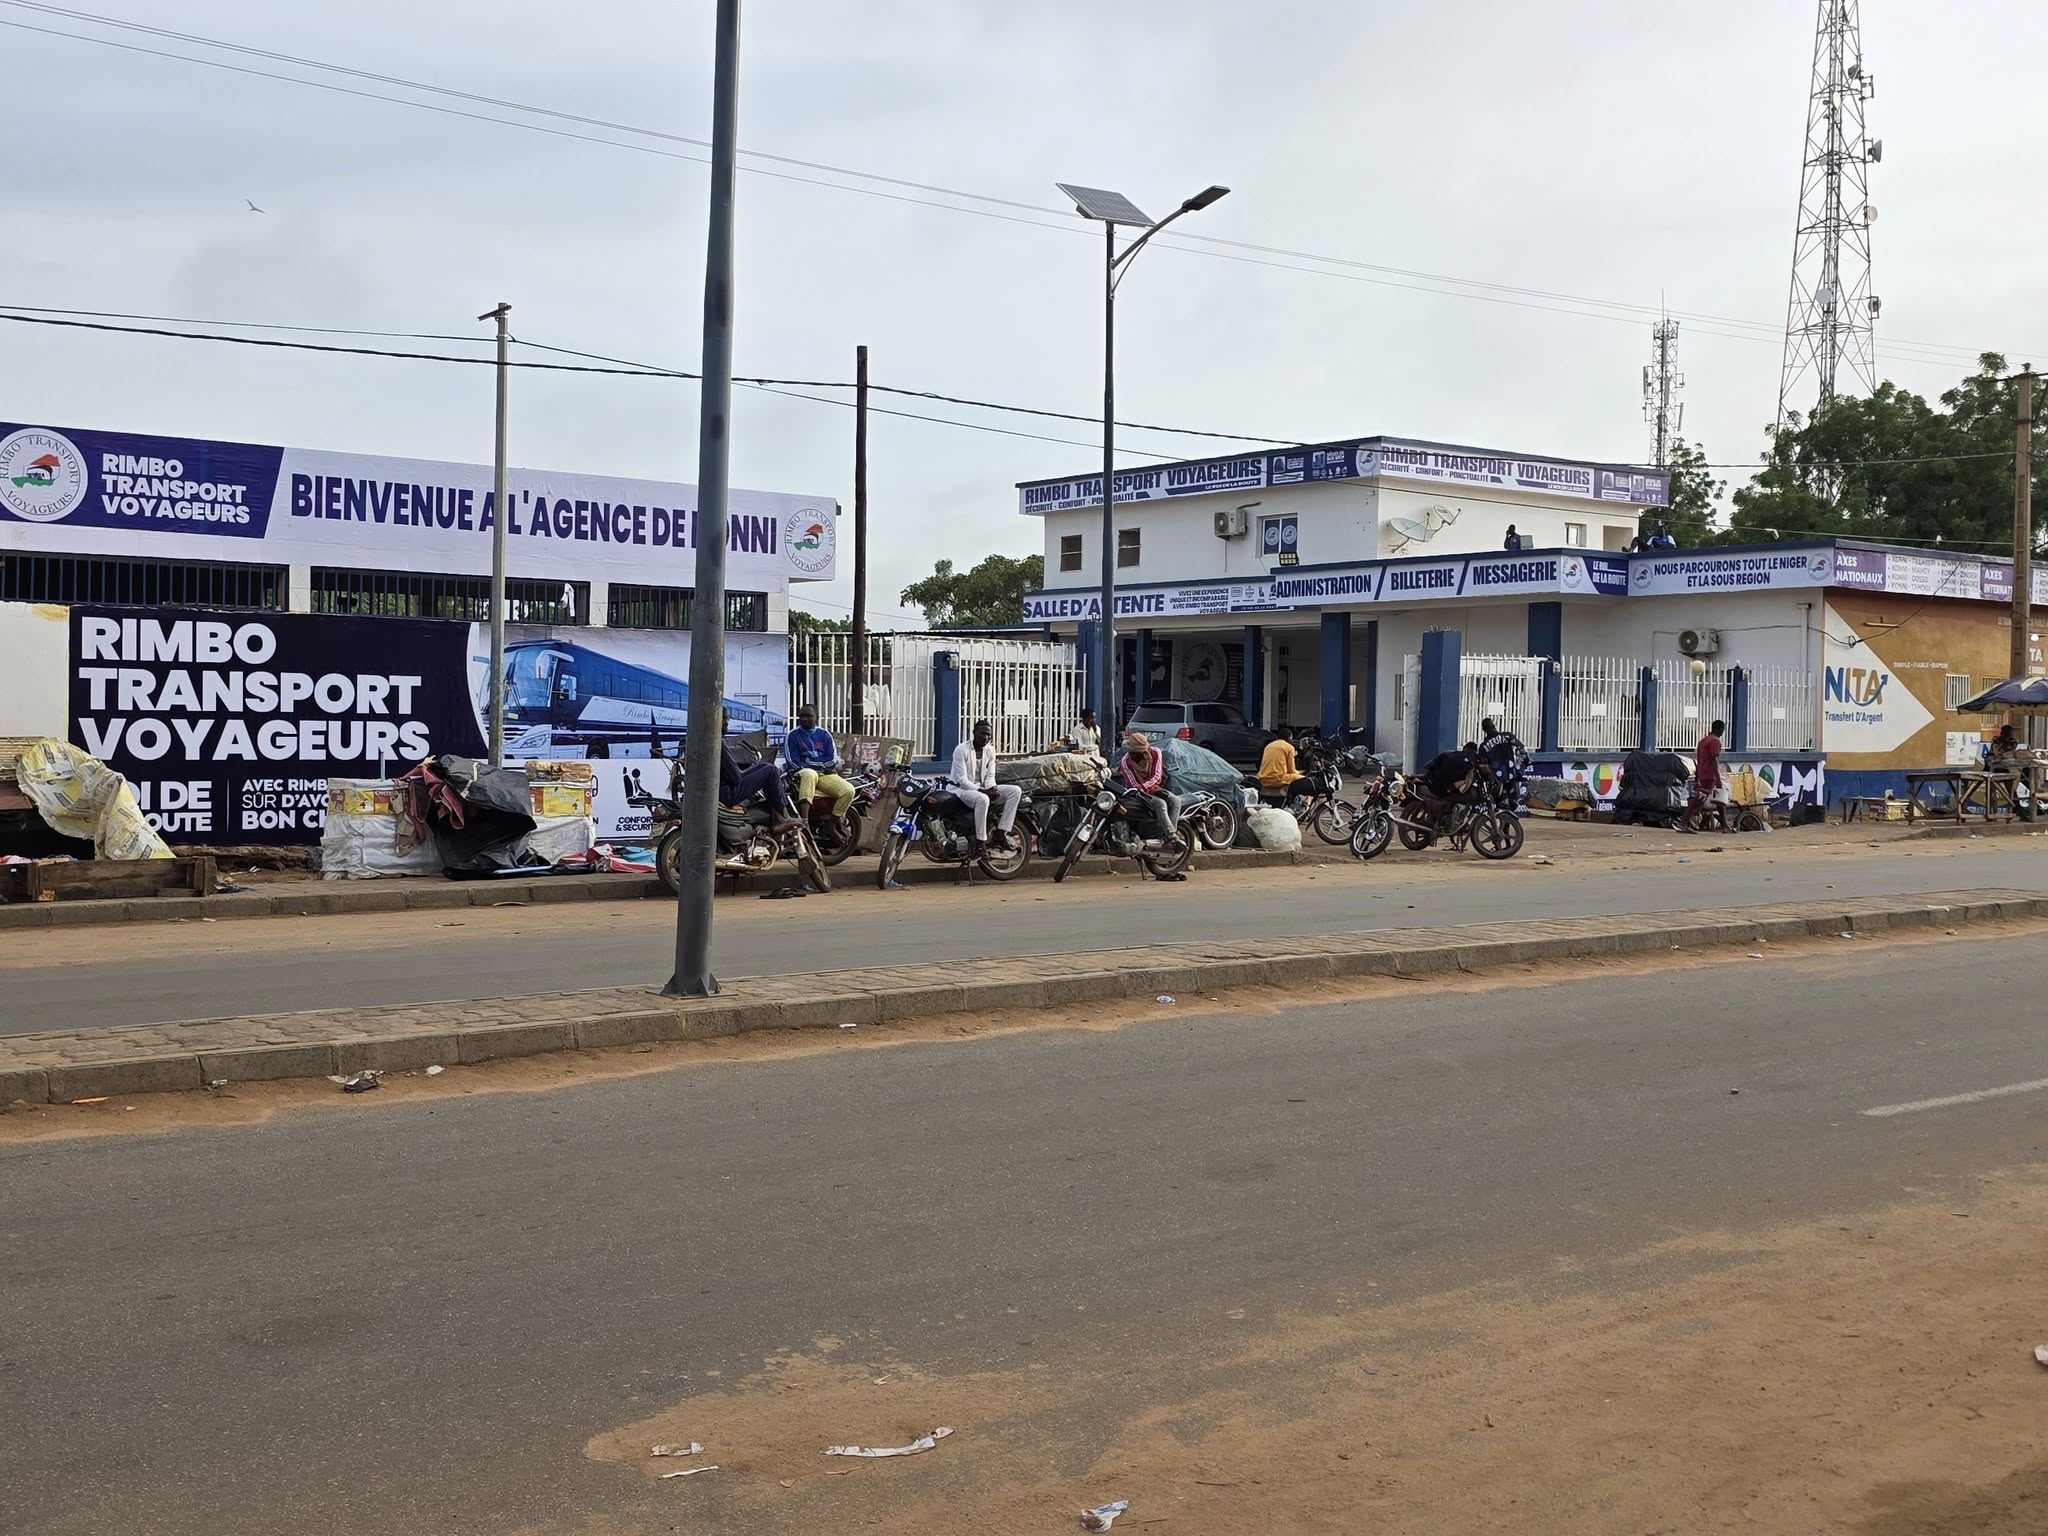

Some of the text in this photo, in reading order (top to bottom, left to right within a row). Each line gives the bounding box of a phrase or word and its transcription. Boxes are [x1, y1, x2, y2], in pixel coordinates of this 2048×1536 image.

[1, 436, 79, 487] RIMBO TRANSPORT
[102, 453, 184, 478] RIMBO
[1380, 461, 1410, 474] SÉCURITÉ
[1415, 468, 1444, 478] CONFORT
[1449, 471, 1490, 483] PONCTUALITÉ
[1381, 446, 1428, 466] RIMBO
[1432, 453, 1514, 477] TRANSPORT
[1517, 463, 1590, 486] VOYAGEURS
[102, 474, 247, 504] TRANSPORT
[1025, 483, 1070, 504] RIMBO
[1075, 471, 1163, 497] TRASPORT
[1167, 458, 1262, 486] VOYAGEURS
[7, 490, 73, 514] VOYAGEURS
[102, 495, 250, 524] VOYAGEURS
[291, 473, 473, 530] BIENVENUE
[508, 490, 647, 544] L'AGENCE
[652, 507, 686, 548] DE
[691, 510, 777, 554] NNI
[1025, 503, 1053, 514] SÉCURITÉ
[1058, 499, 1086, 509] CONFORT
[1091, 492, 1134, 506] PONUALITÉ
[791, 552, 832, 572] VOYAGEURS
[1654, 563, 1679, 575] NOUS
[1680, 559, 1741, 574] PARCOURONS
[1742, 558, 1767, 571] TOUT
[1768, 558, 1779, 570] LE
[1779, 556, 1808, 569] NIGER
[1837, 555, 1857, 567] AXES
[1391, 568, 1454, 591] BILLETERIE
[1473, 561, 1557, 585] MESSAGERIE
[1600, 573, 1608, 584] LA
[1608, 574, 1626, 586] ROUTE
[1687, 572, 1770, 587] ET LA SOUS REGION
[1836, 571, 1884, 584] NATIONAUX
[1984, 569, 2003, 580] AXES
[1276, 574, 1371, 598] ADMINISTRATION
[1023, 594, 1165, 619] SALLE D'ATENTE
[82, 616, 277, 664] RIMBO
[2029, 648, 2043, 662] TA
[79, 667, 422, 714] TRANSPORT
[1825, 666, 1883, 706] NITA
[1825, 711, 1883, 725] Transfert D'Argent
[79, 717, 430, 761] VOYAGEURS
[160, 780, 212, 810] DE
[242, 779, 328, 792] AVEC RIMB
[242, 792, 277, 809] SÛR
[282, 794, 329, 808] D'AVO
[145, 812, 212, 833] OUTE
[242, 810, 296, 831] BON
[619, 816, 653, 824] CONFOR
